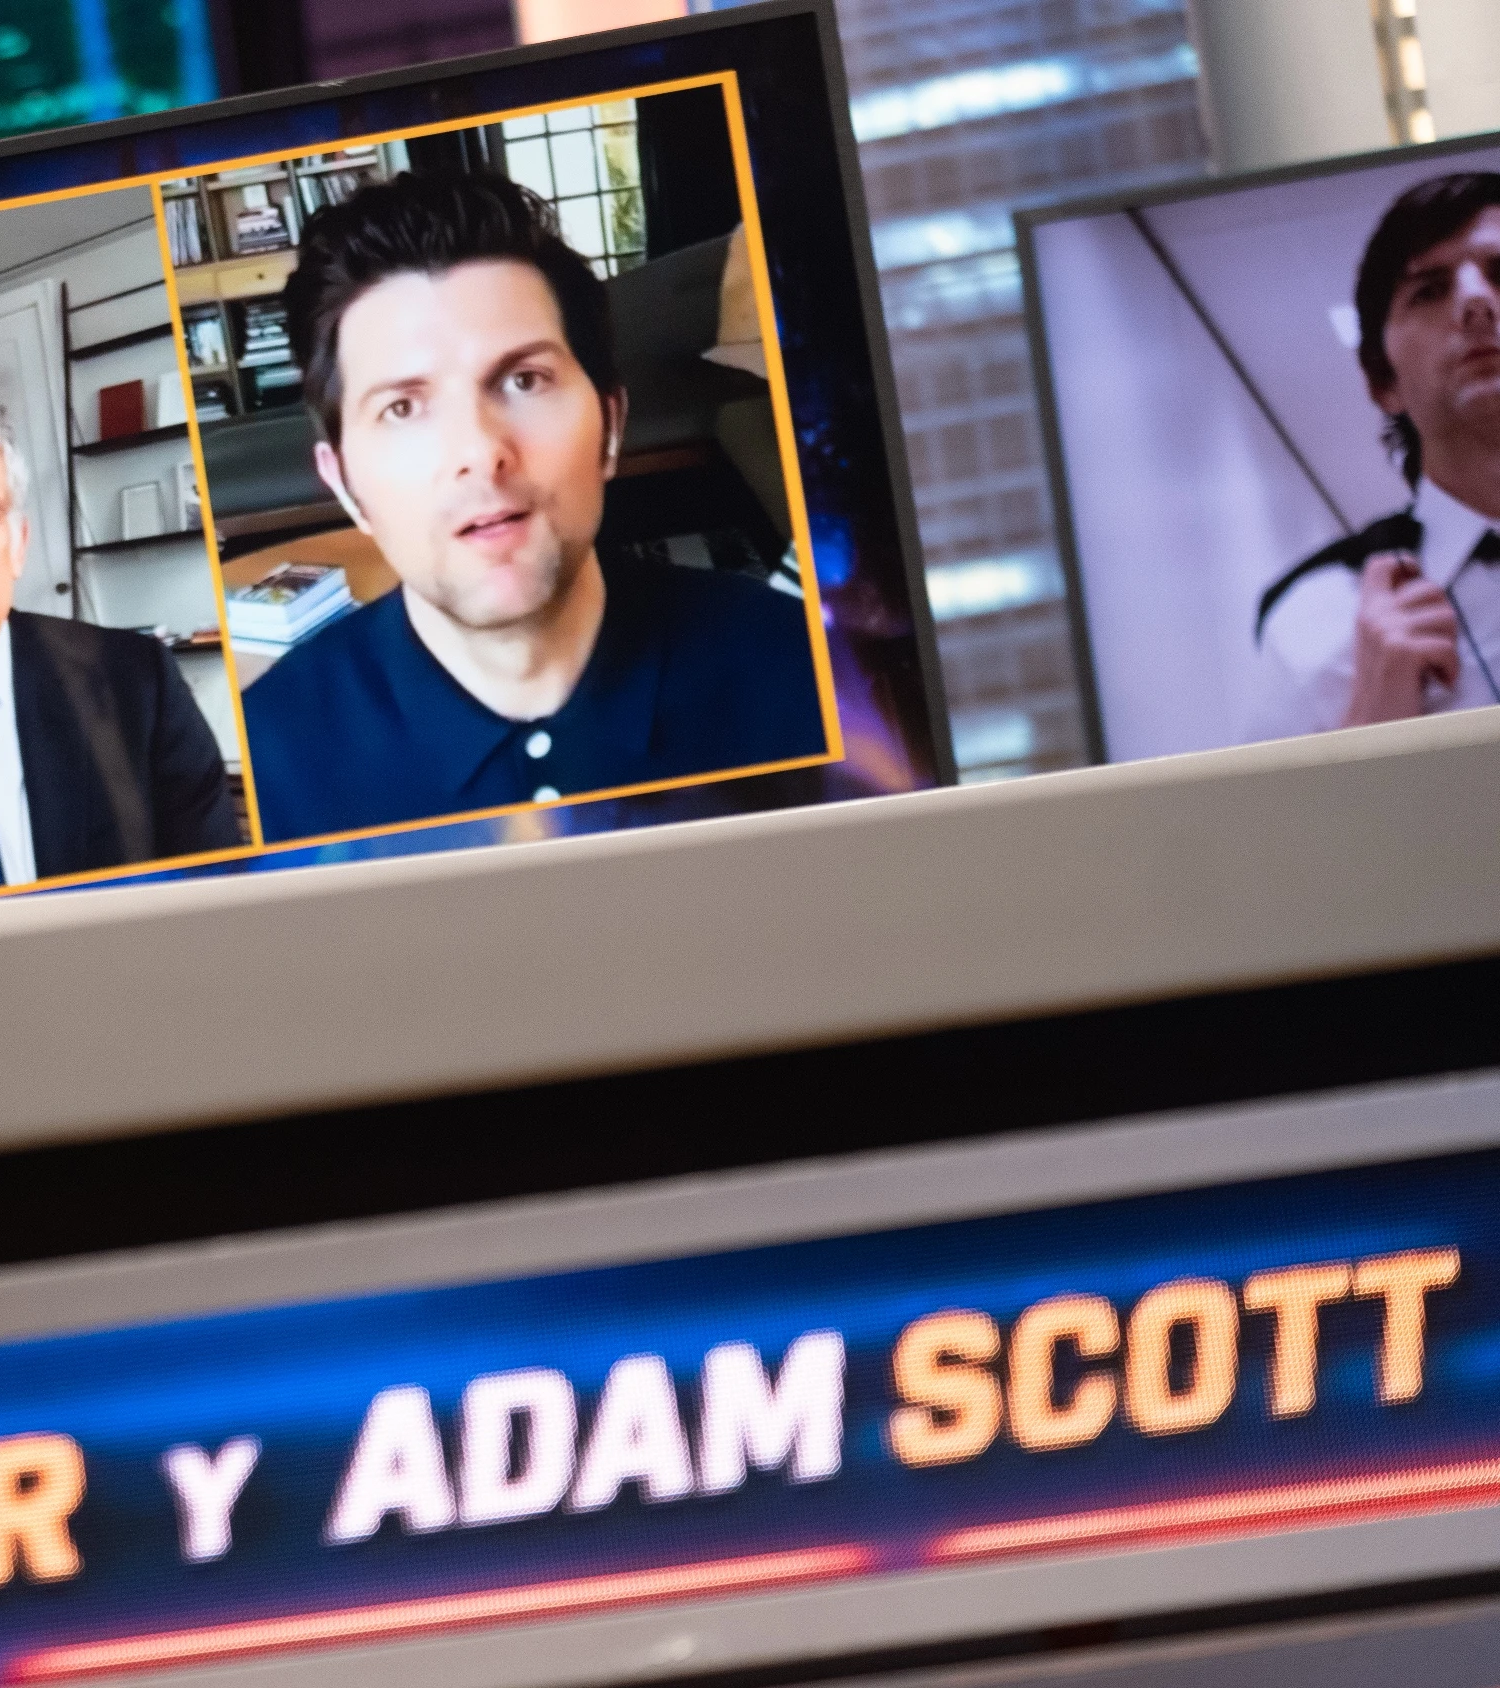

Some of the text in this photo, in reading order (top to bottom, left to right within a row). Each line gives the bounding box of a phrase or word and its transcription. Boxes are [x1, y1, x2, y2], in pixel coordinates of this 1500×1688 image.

[162, 1434, 262, 1563] Y
[324, 1328, 845, 1545] ADAM
[886, 1245, 1461, 1468] SCOTT
